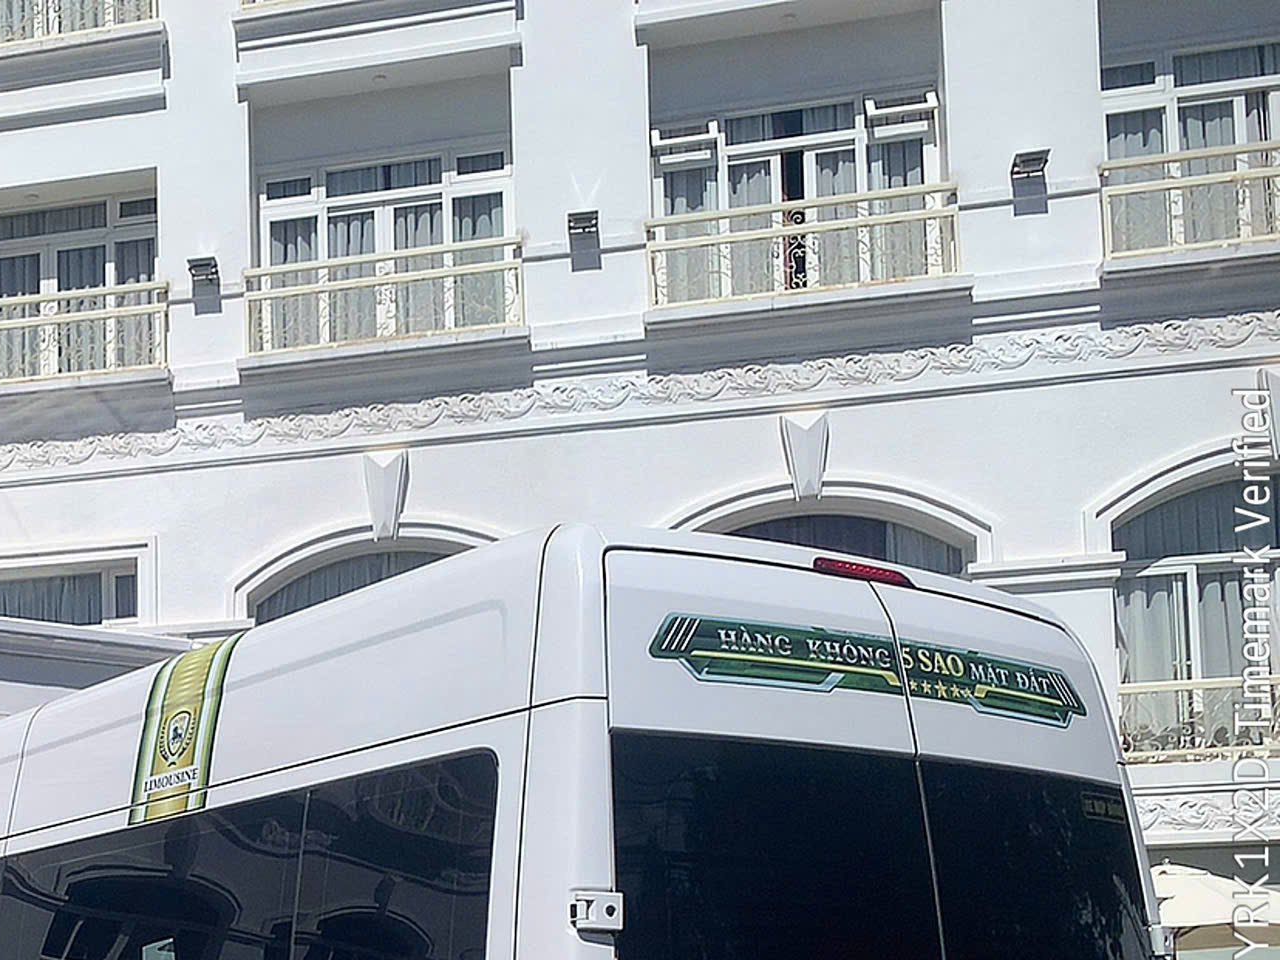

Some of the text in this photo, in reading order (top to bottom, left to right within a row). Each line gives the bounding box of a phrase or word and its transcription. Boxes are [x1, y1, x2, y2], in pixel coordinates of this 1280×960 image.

[716, 625, 792, 655] HÀNG
[806, 639, 891, 668] KHÔNG
[902, 647, 914, 669] 5
[917, 648, 964, 677] SAO
[144, 767, 198, 793] LIMOUSINE
